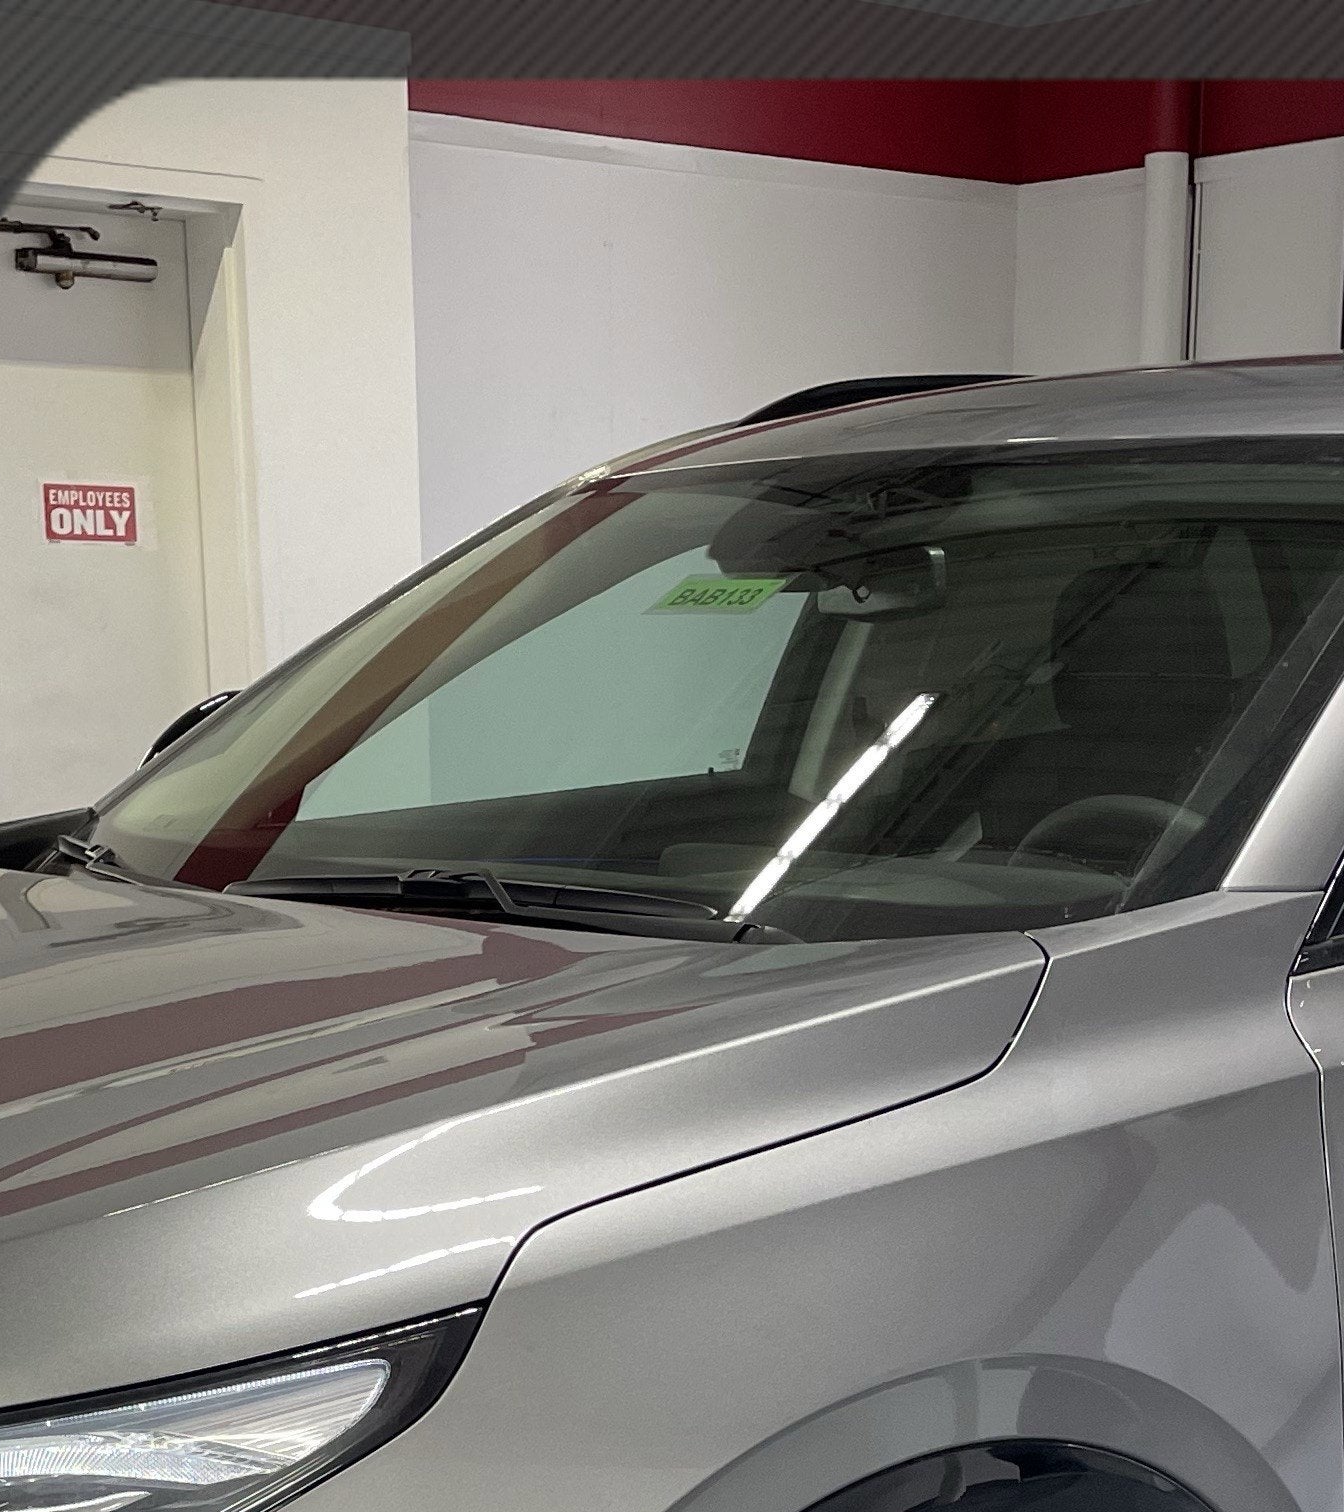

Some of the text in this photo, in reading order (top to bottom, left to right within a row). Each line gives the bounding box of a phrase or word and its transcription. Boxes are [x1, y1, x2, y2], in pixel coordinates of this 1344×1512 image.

[48, 488, 131, 508] EMPLOYEES
[49, 507, 132, 537] ONLY
[667, 588, 765, 607] BAB133
